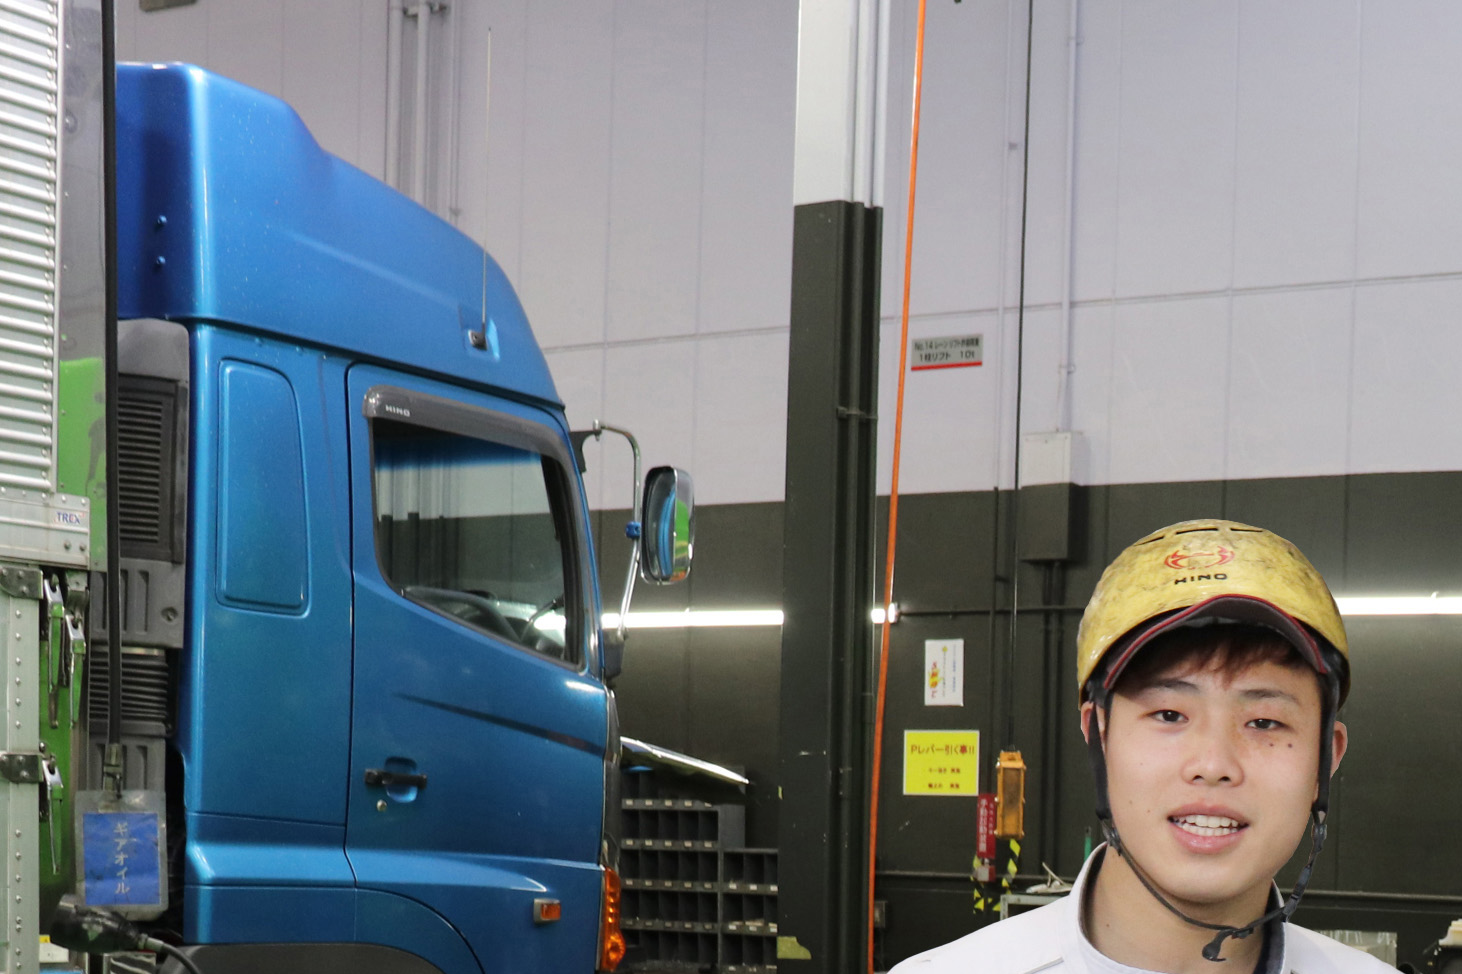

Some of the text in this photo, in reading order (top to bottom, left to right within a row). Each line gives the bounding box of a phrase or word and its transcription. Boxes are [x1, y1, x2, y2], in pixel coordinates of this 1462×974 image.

[385, 404, 411, 418] HINO
[1174, 573, 1229, 585] HINO
[113, 821, 131, 895] ギアオイル
